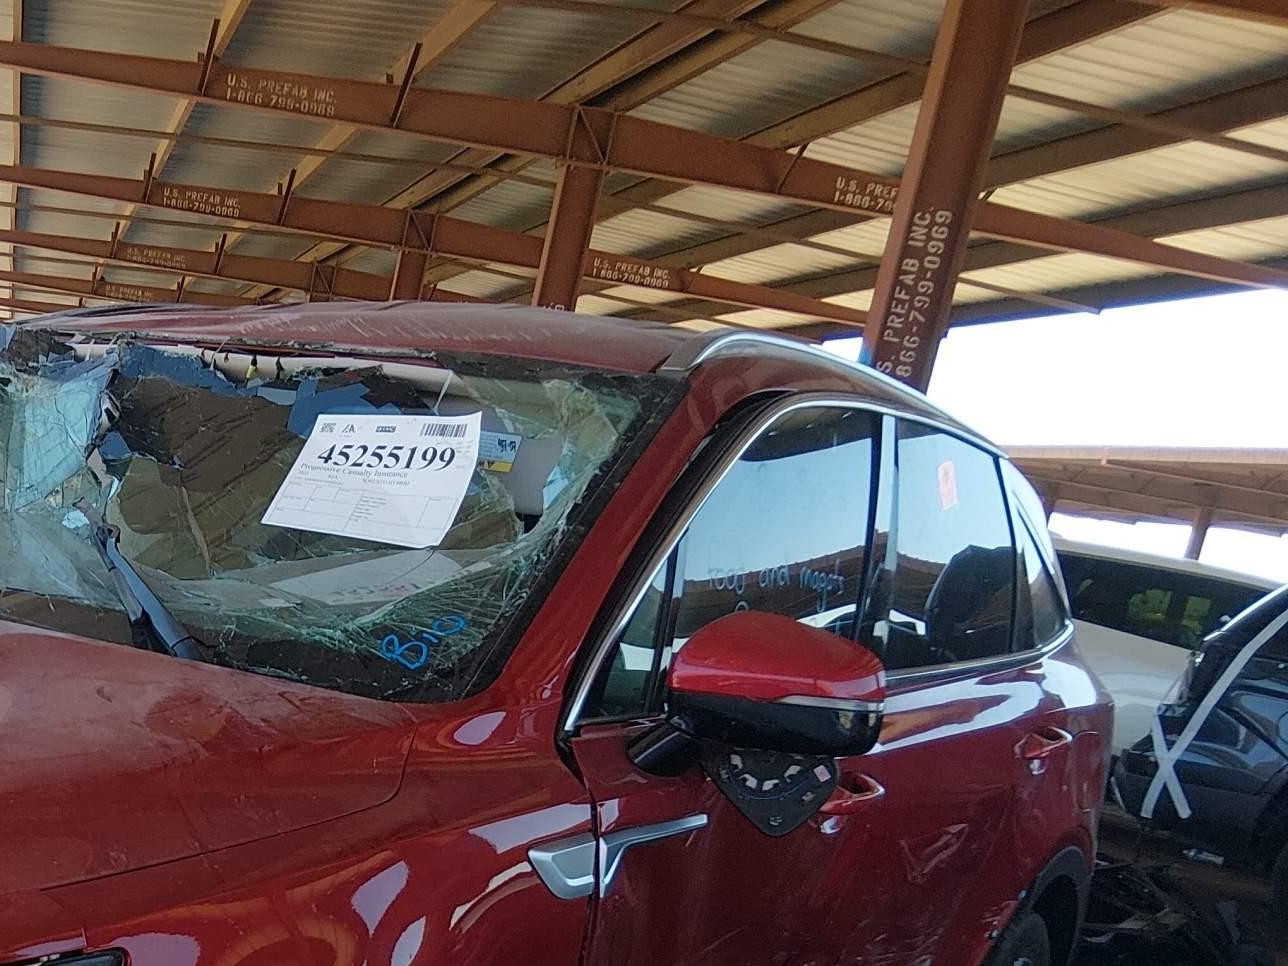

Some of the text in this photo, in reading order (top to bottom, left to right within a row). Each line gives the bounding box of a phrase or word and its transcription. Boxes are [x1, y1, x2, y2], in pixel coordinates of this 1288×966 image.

[259, 80, 308, 98] PREFAB
[836, 176, 860, 193] U.S.
[883, 258, 919, 342] PREFAB
[908, 207, 935, 247] INC.
[317, 444, 456, 471] 45255199
